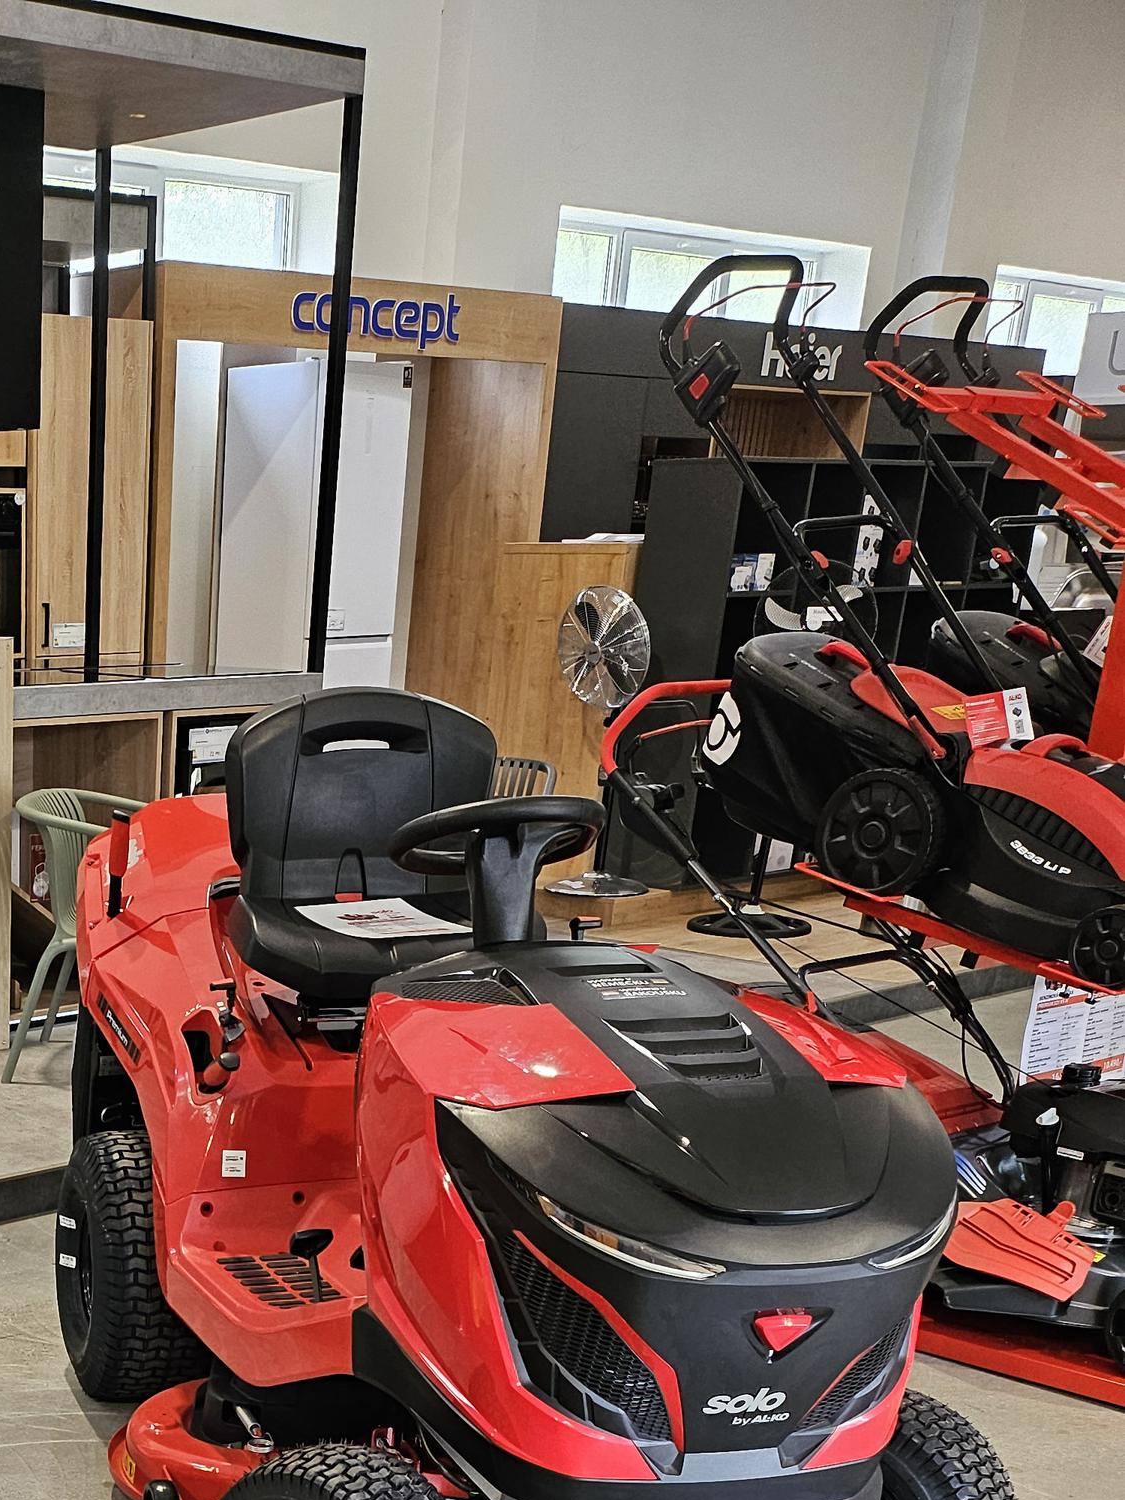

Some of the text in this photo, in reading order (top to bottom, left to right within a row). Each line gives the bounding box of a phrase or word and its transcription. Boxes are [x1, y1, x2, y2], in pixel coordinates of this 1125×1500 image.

[291, 291, 461, 350] concept
[106, 1009, 129, 1047] Premium
[702, 1387, 787, 1415] solo
[731, 1416, 752, 1427] by
